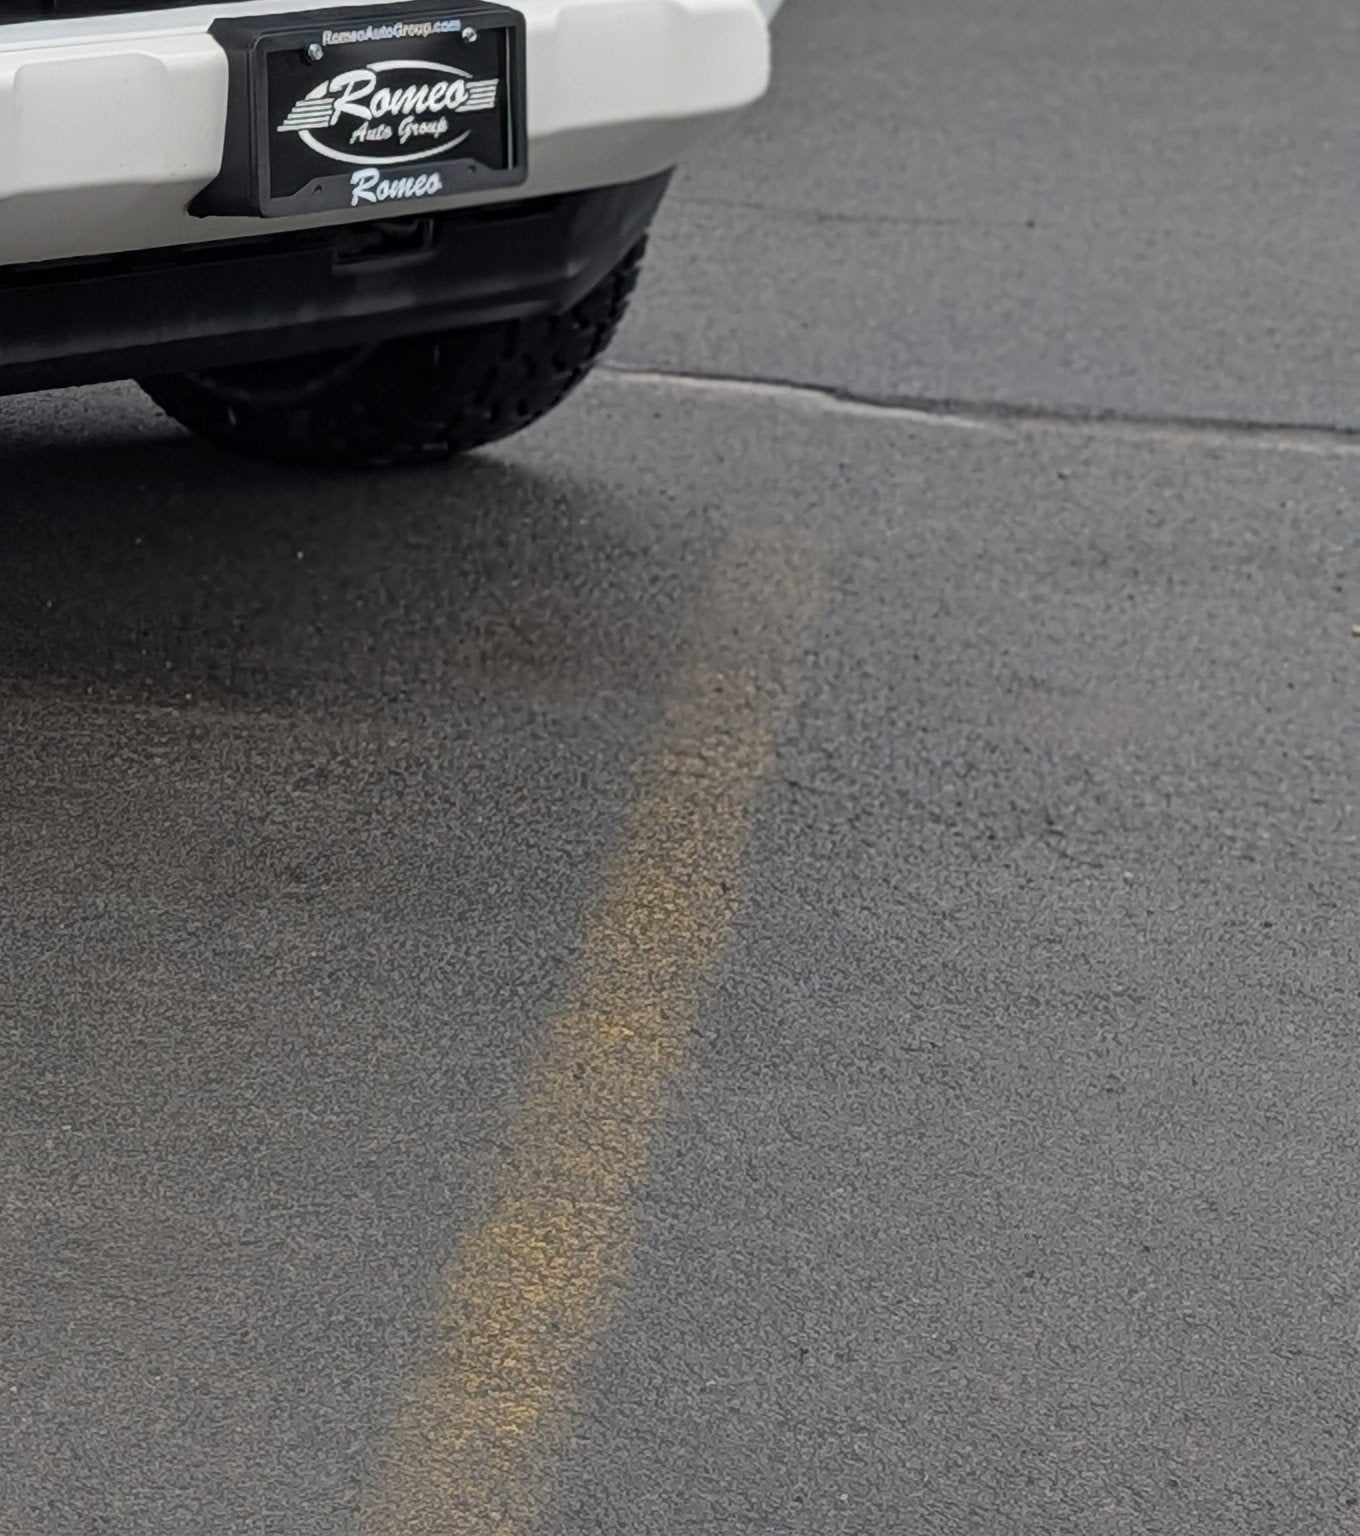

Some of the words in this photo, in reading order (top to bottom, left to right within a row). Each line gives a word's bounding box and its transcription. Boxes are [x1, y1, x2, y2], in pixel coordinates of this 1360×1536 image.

[322, 19, 462, 47] RomeoAutoGroup.com
[329, 69, 469, 126] Romeo
[349, 120, 393, 145] Auto
[398, 115, 449, 145] Group
[350, 167, 443, 207] Romeo
